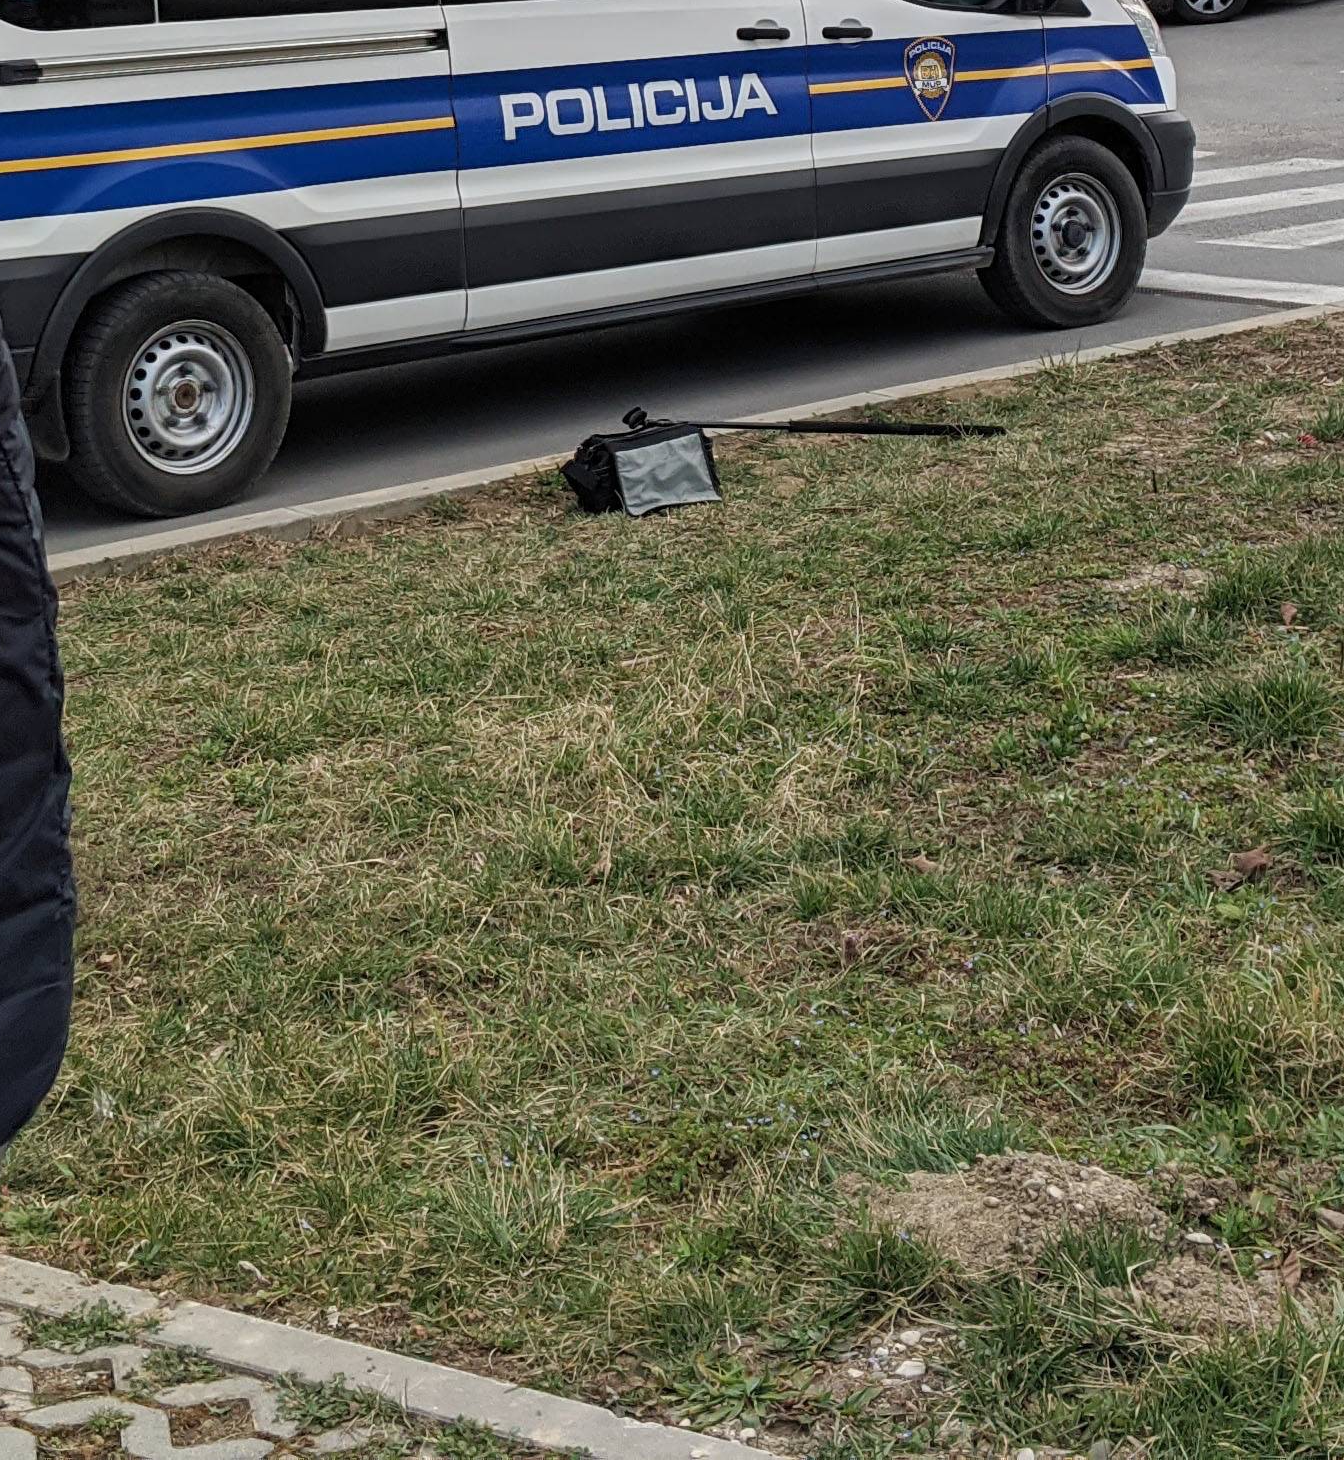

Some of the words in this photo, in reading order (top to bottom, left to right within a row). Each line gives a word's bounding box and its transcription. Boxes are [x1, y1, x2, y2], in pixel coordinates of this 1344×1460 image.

[909, 41, 952, 59] POLICIJA
[921, 80, 942, 89] MUP
[499, 72, 778, 141] POLICIJA
